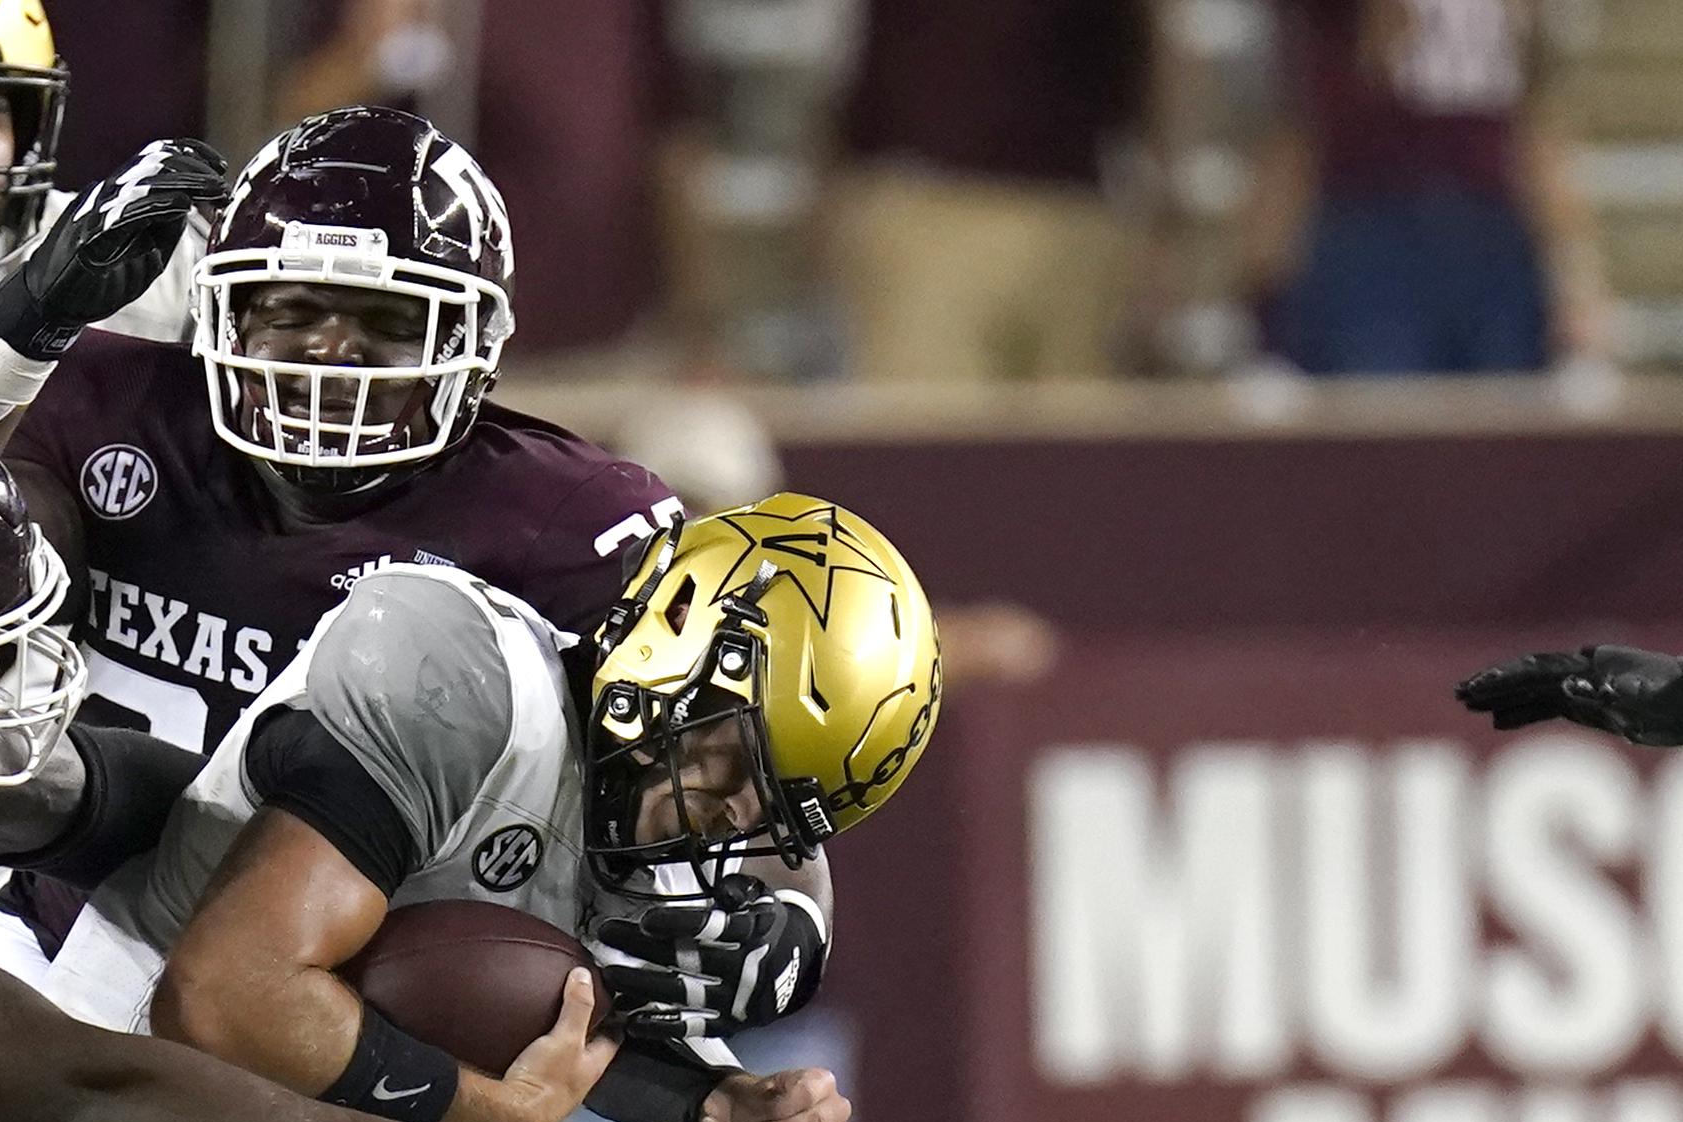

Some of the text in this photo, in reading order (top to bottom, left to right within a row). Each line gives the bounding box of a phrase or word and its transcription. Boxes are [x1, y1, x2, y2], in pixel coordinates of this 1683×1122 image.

[316, 232, 357, 247] AGGIES
[88, 452, 150, 514] SEC
[88, 568, 273, 694] TEXAS
[478, 827, 538, 886] SEC
[1029, 737, 1683, 1084] MUS
